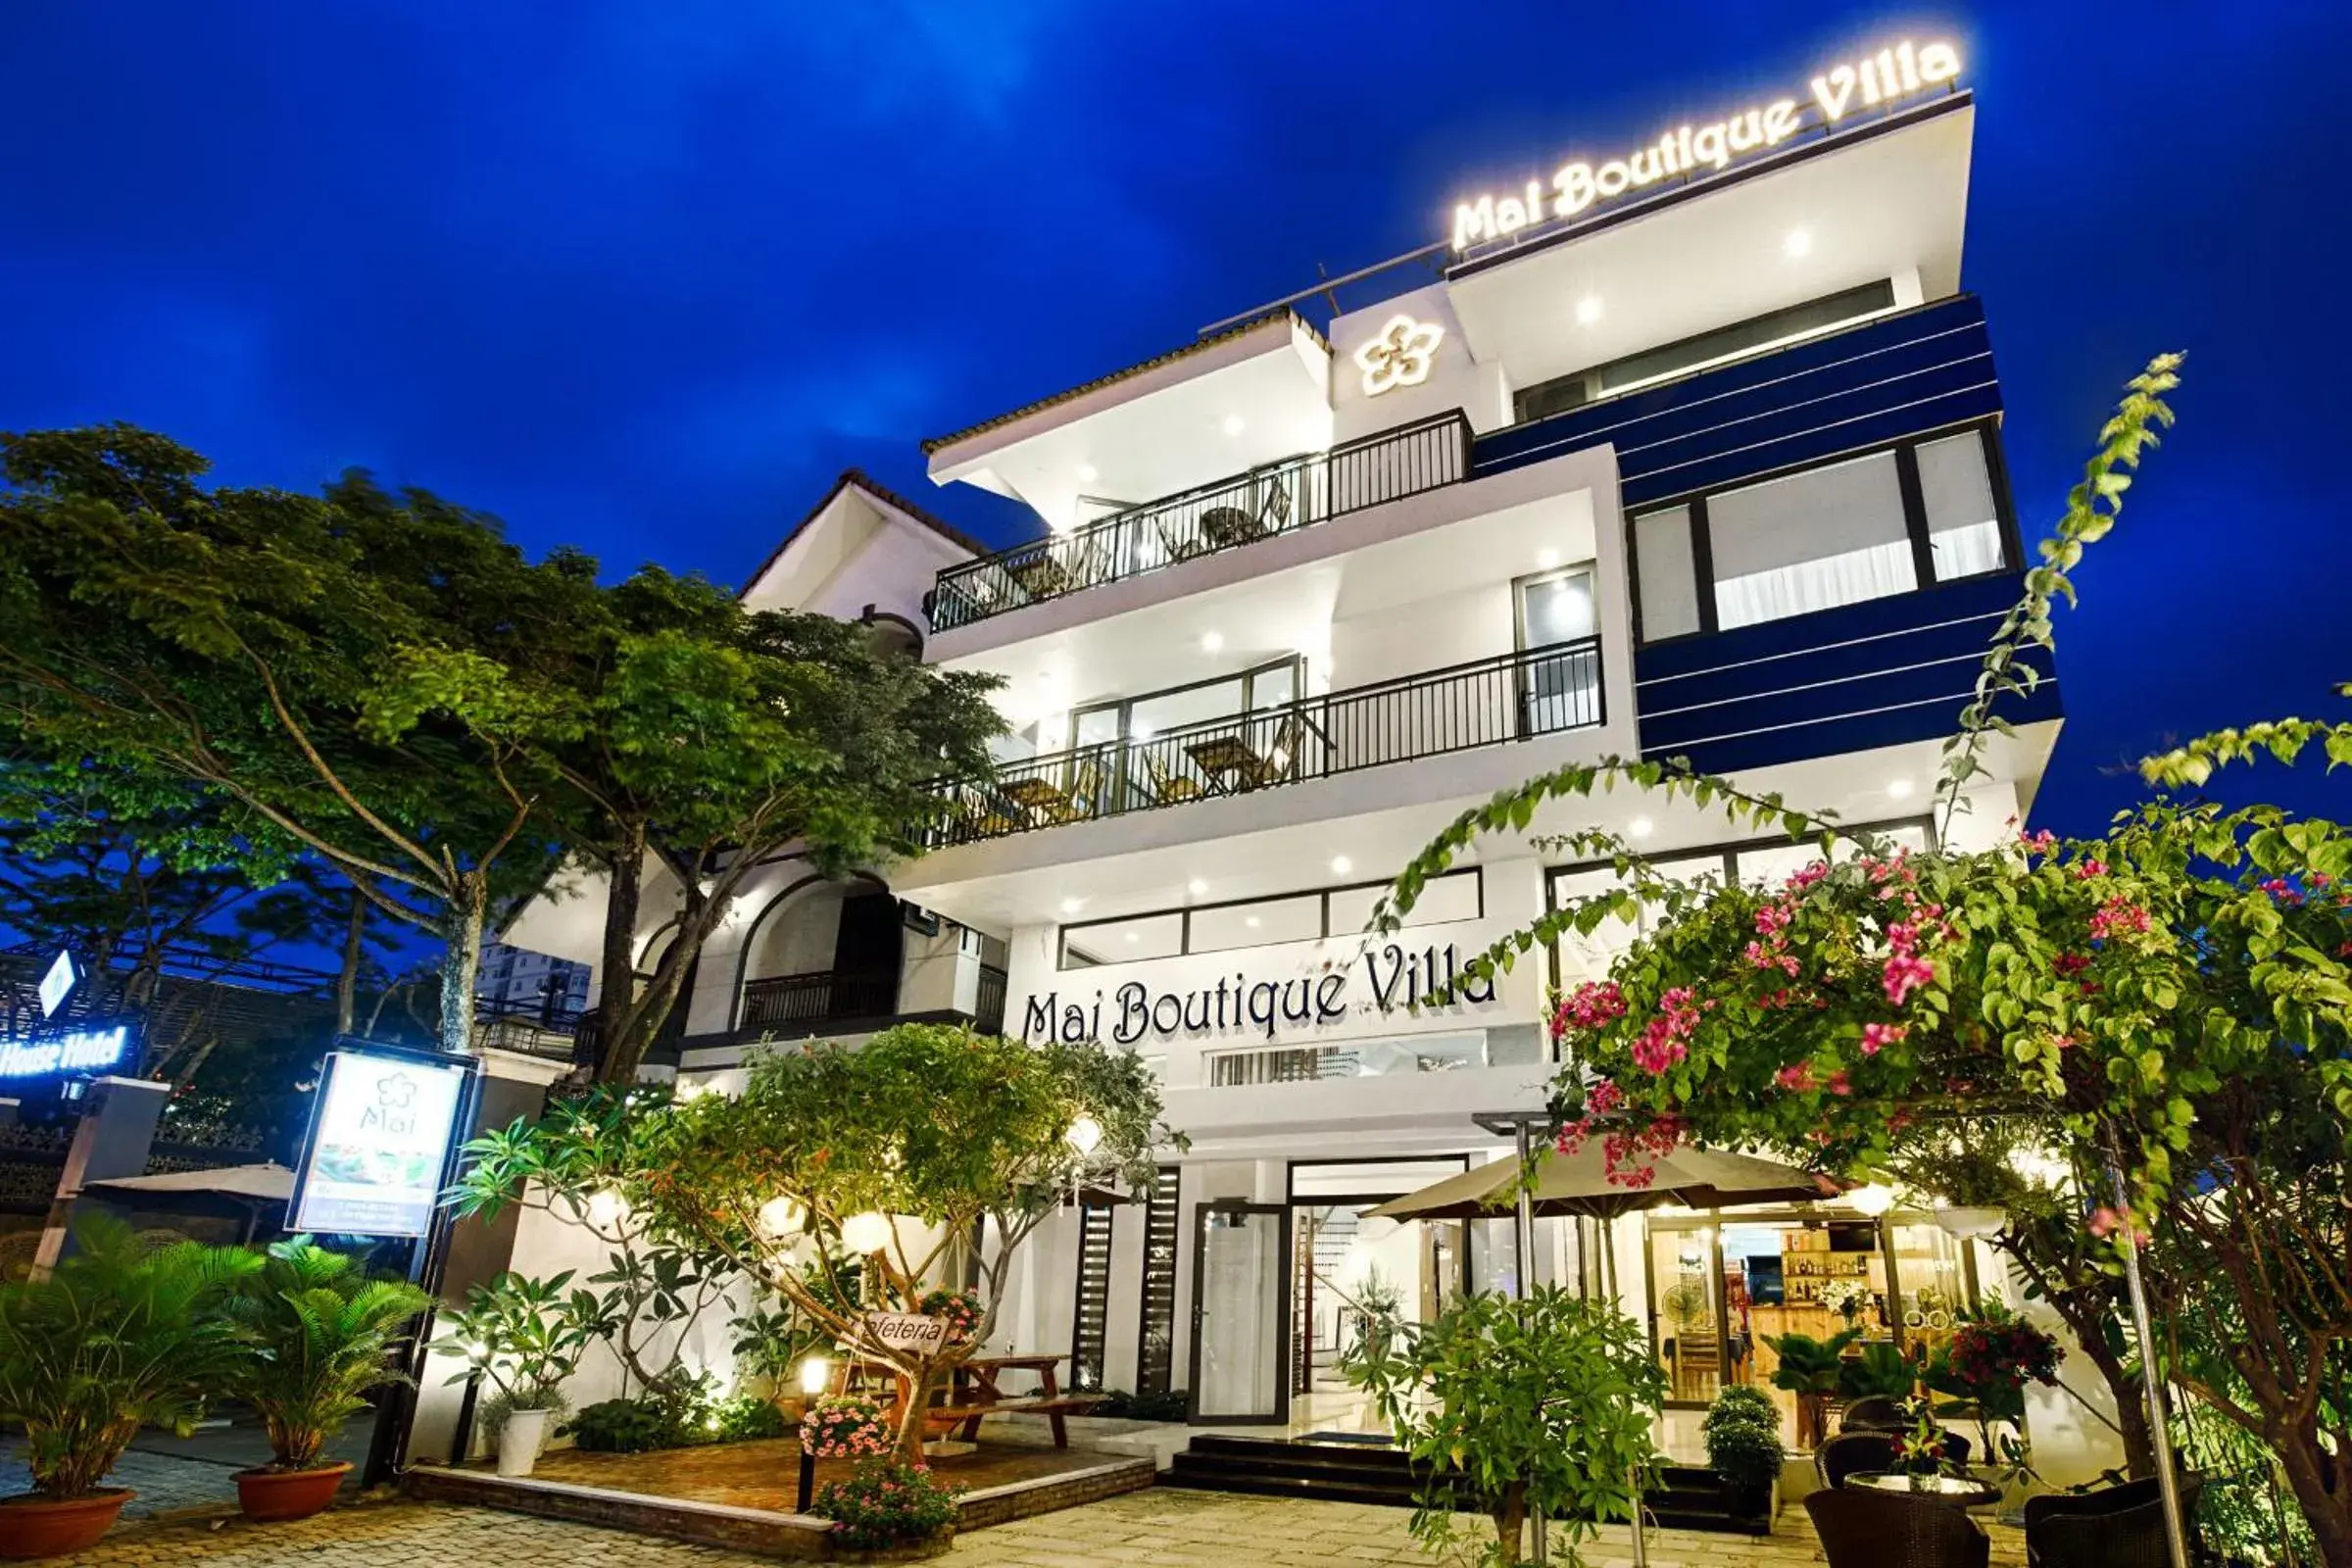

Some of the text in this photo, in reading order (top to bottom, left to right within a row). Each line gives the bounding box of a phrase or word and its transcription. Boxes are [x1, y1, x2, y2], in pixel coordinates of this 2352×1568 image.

[1451, 39, 1960, 253] Mai Boutique Villa
[1022, 943, 1496, 1045] Mai Boutique Villa
[61, 1026, 126, 1068] Hotel
[360, 1106, 417, 1134] Mai
